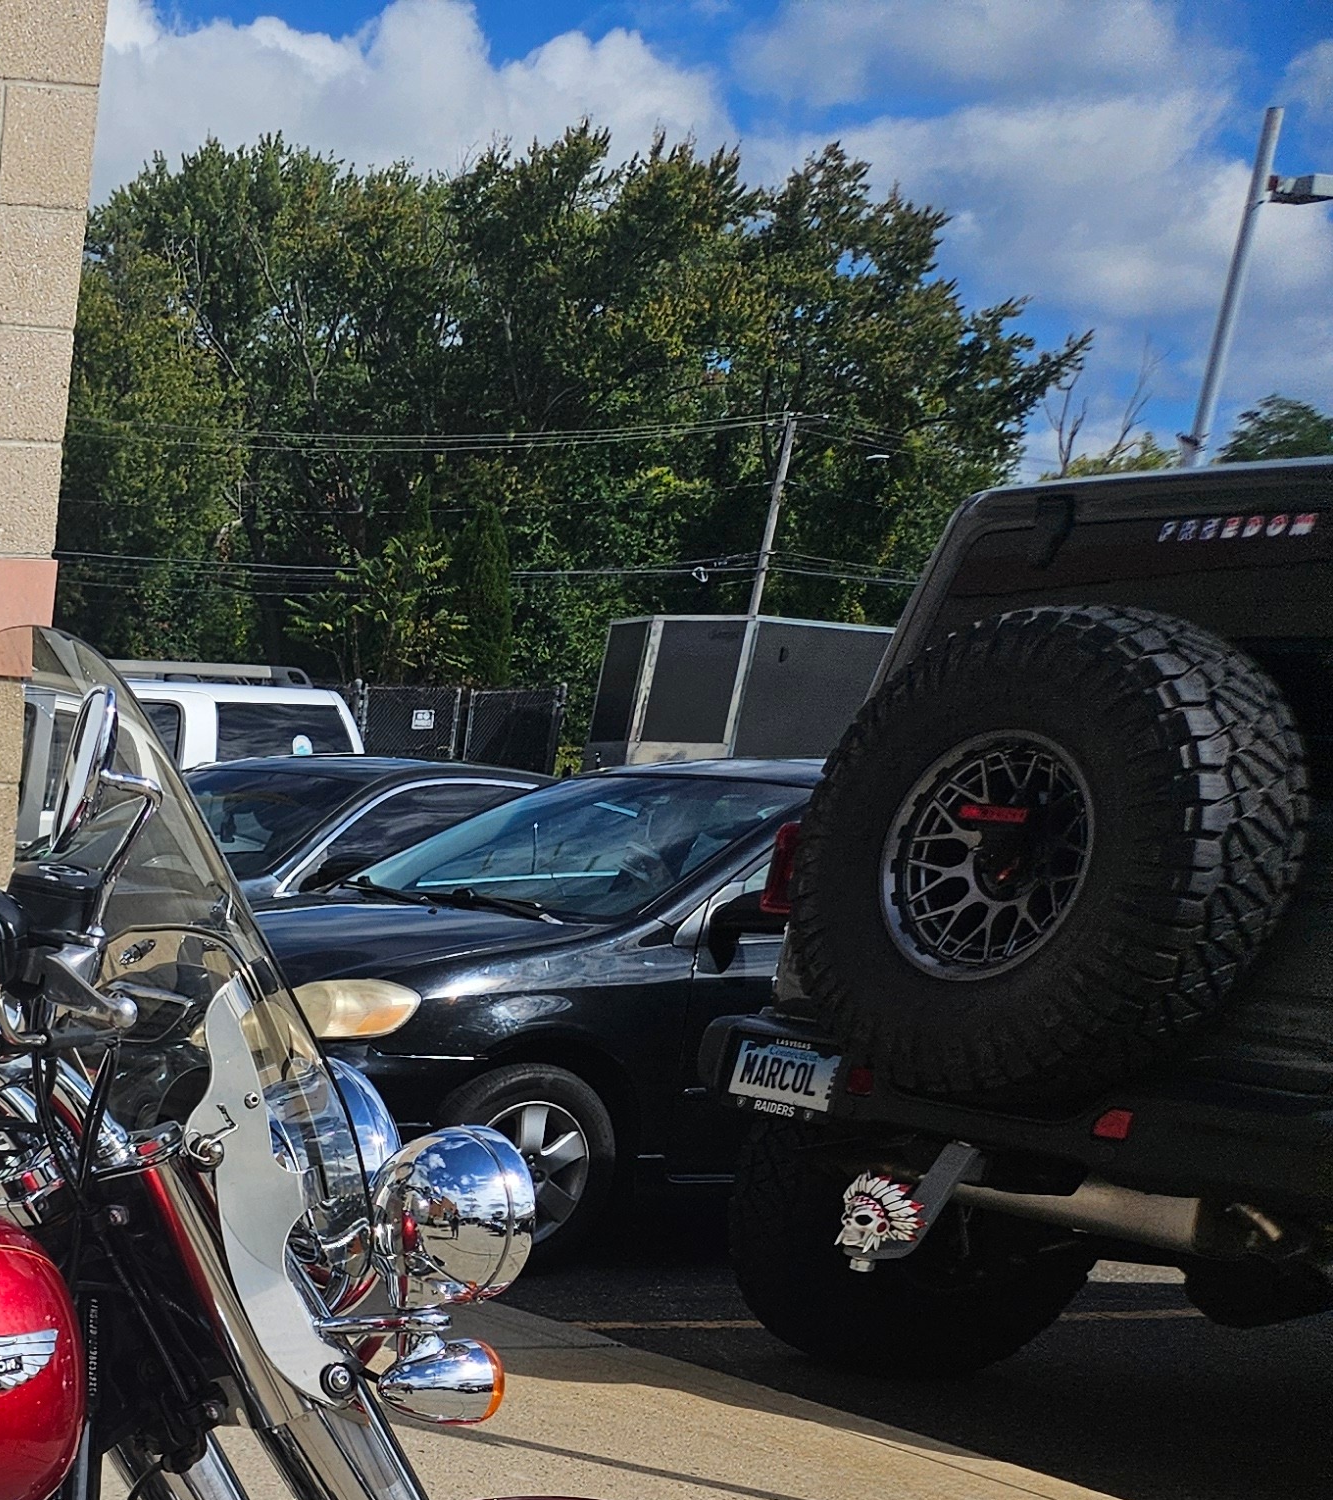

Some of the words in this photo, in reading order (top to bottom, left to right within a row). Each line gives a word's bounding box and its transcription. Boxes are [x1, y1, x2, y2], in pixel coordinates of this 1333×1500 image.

[1157, 513, 1320, 543] FREEDOM
[739, 1053, 816, 1096] MARCOL
[754, 1100, 795, 1117] RAIDERS
